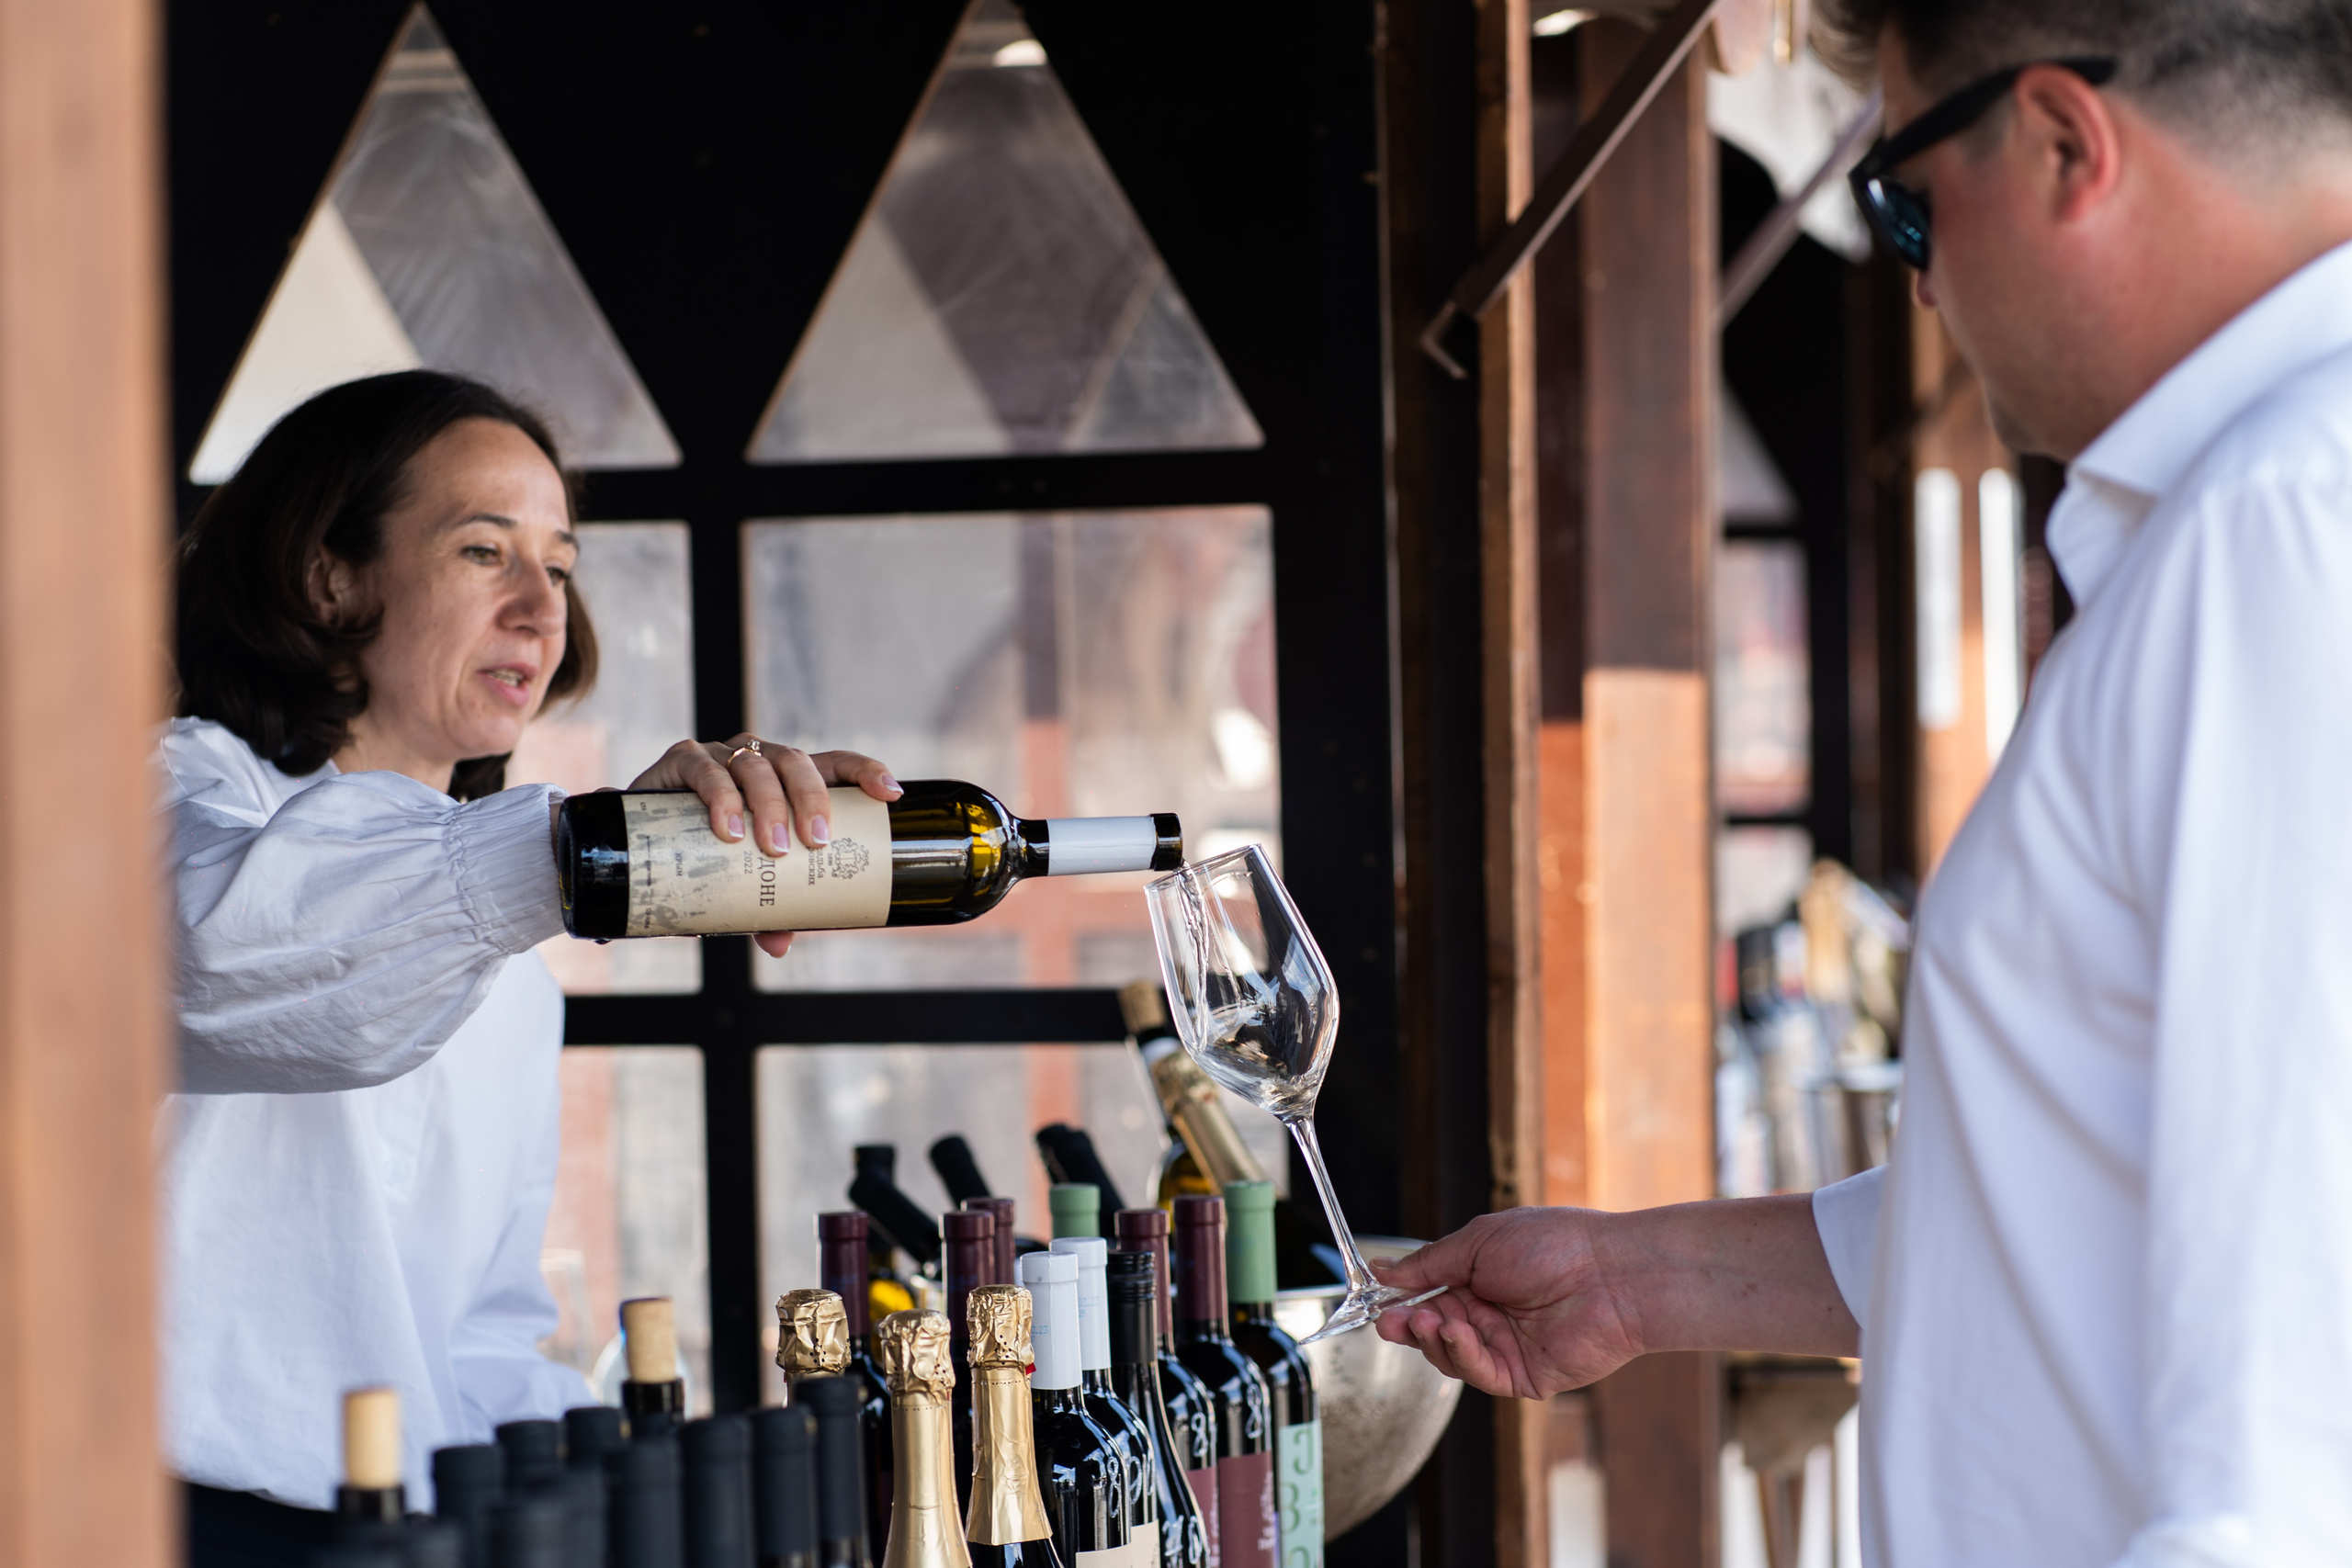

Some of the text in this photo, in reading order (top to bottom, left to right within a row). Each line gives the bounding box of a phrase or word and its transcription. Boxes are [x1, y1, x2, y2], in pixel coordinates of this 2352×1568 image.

[674, 852, 683, 876] КРЫМ
[743, 851, 753, 874] 2022
[806, 846, 816, 886] ровских
[814, 848, 825, 878] садьба
[757, 851, 776, 907] ДОНЕ
